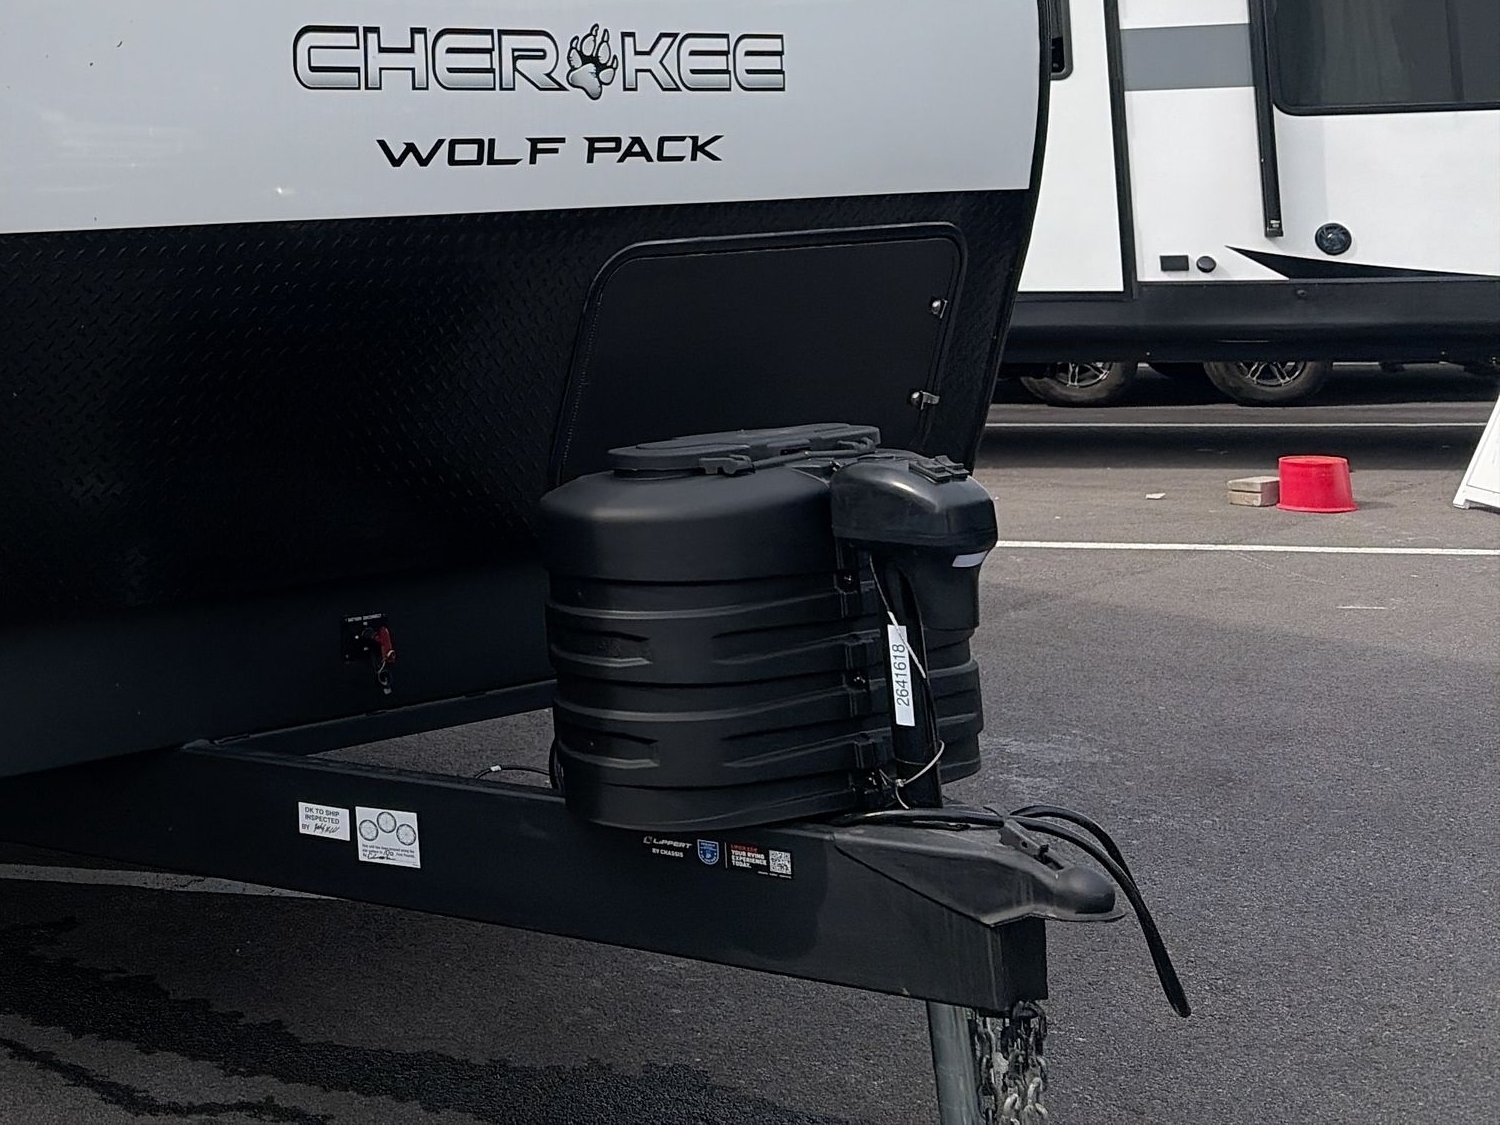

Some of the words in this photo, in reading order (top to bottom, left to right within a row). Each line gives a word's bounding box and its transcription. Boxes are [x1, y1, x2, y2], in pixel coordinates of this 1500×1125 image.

[376, 137, 567, 168] WOLF
[582, 135, 725, 164] PACK
[891, 643, 910, 707] 2641618
[304, 814, 340, 825] INSPECTED
[325, 809, 340, 817] SHIP
